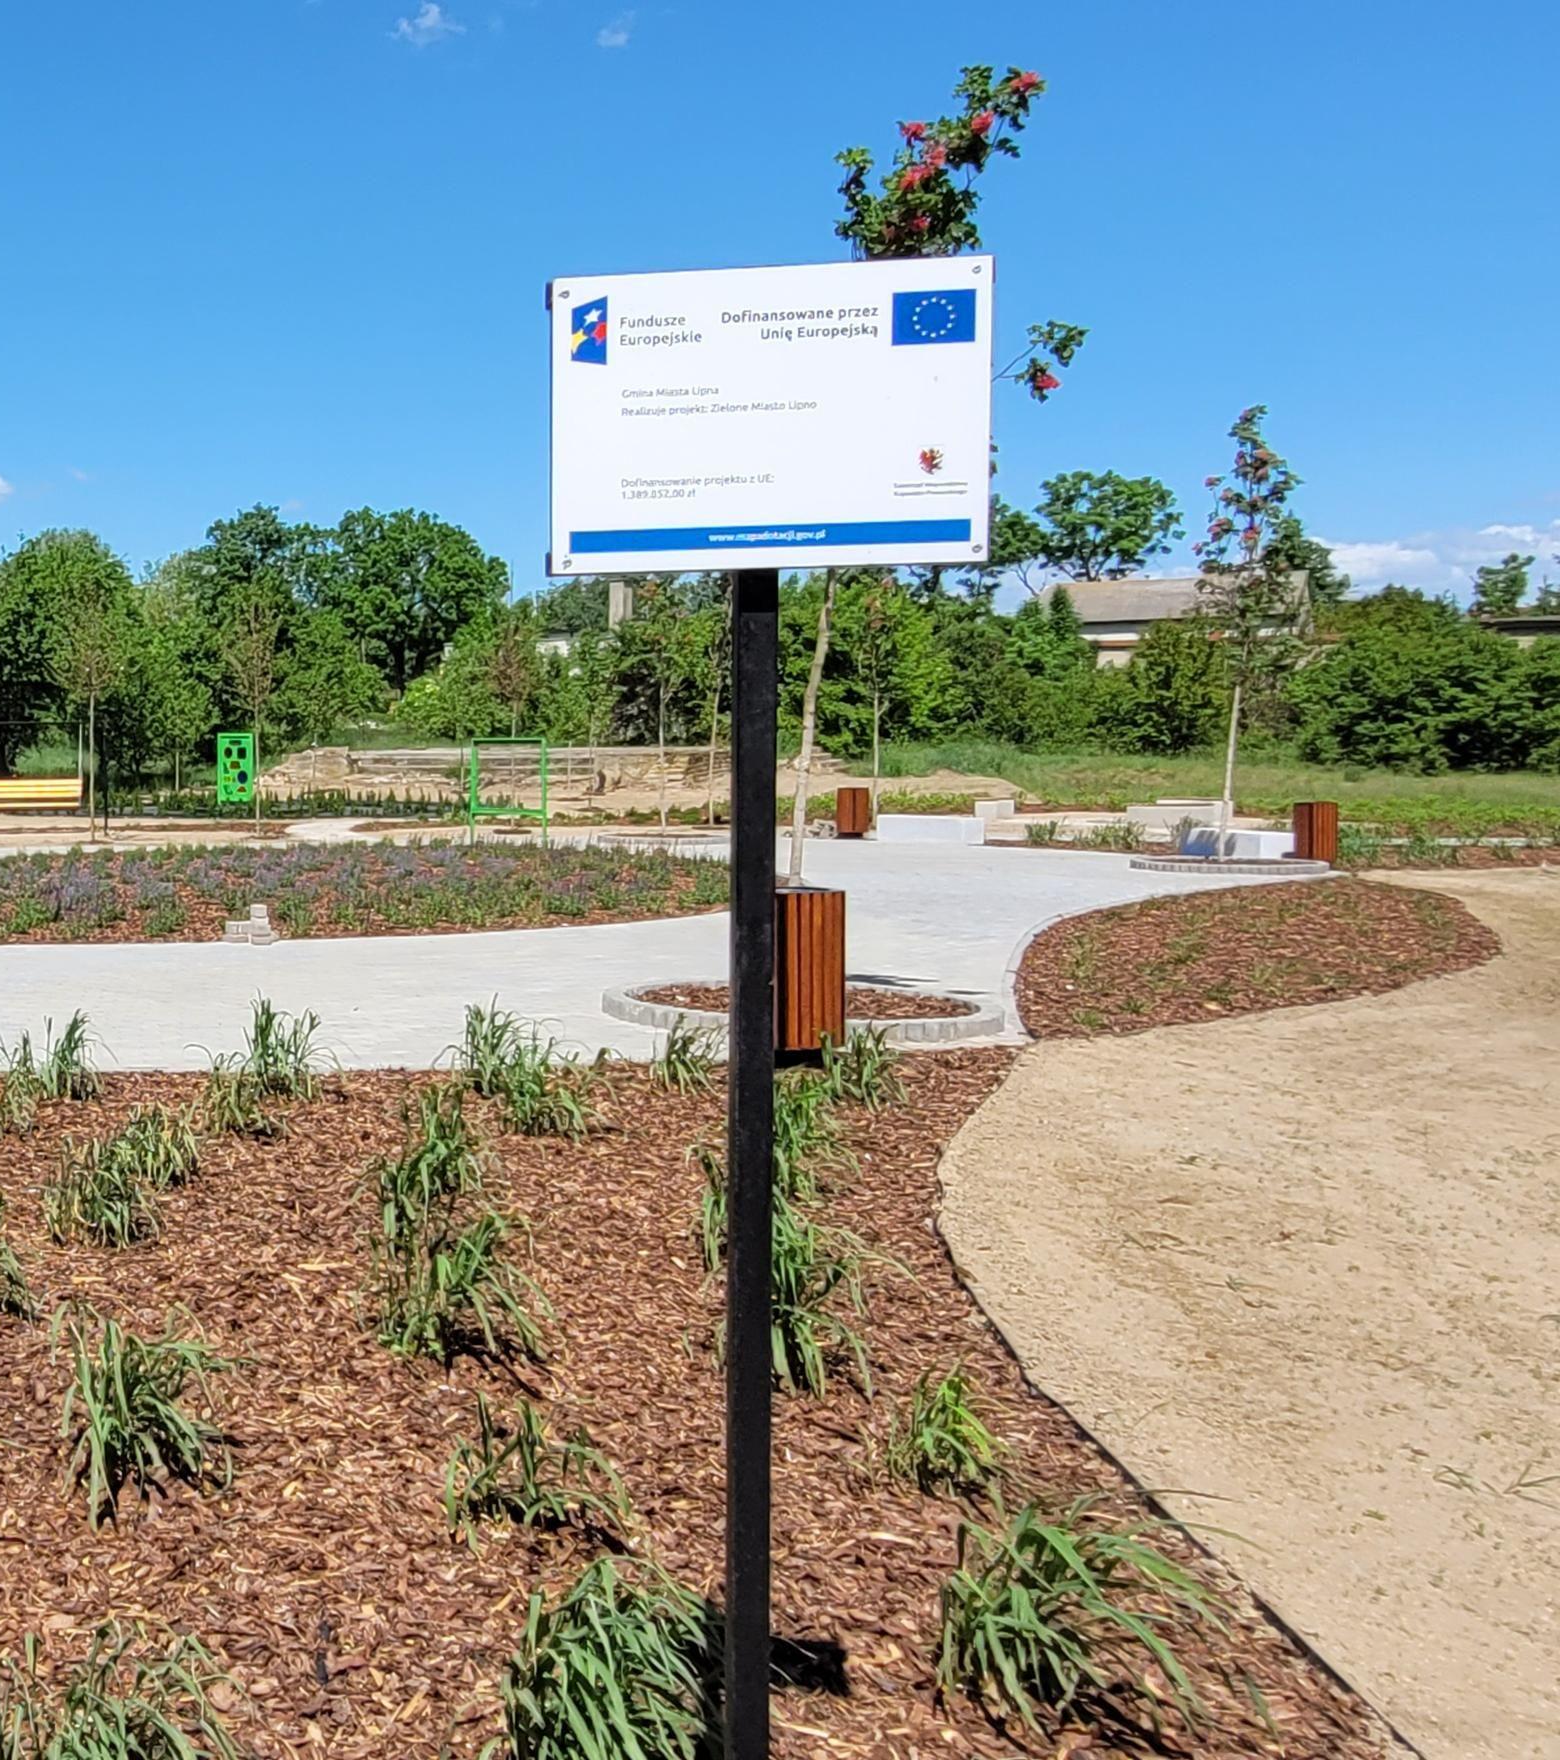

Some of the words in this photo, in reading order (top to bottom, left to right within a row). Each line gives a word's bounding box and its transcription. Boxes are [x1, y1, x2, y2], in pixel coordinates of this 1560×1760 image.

[620, 315, 686, 329] Fundusze
[721, 308, 834, 324] Dofinansowane
[838, 307, 879, 321] przez
[620, 330, 702, 347] Europejskie
[760, 327, 793, 341] Unię
[797, 323, 878, 339] Europejską
[621, 388, 654, 399] Gmina
[656, 387, 689, 397] Miasta
[691, 385, 719, 397] Lipna
[621, 406, 666, 417] Realizuje
[710, 402, 749, 414] Zielone
[751, 401, 786, 412] Miasto
[788, 400, 817, 411] Lipno
[621, 476, 702, 488] Dofinansowanie
[704, 474, 748, 487] projektu
